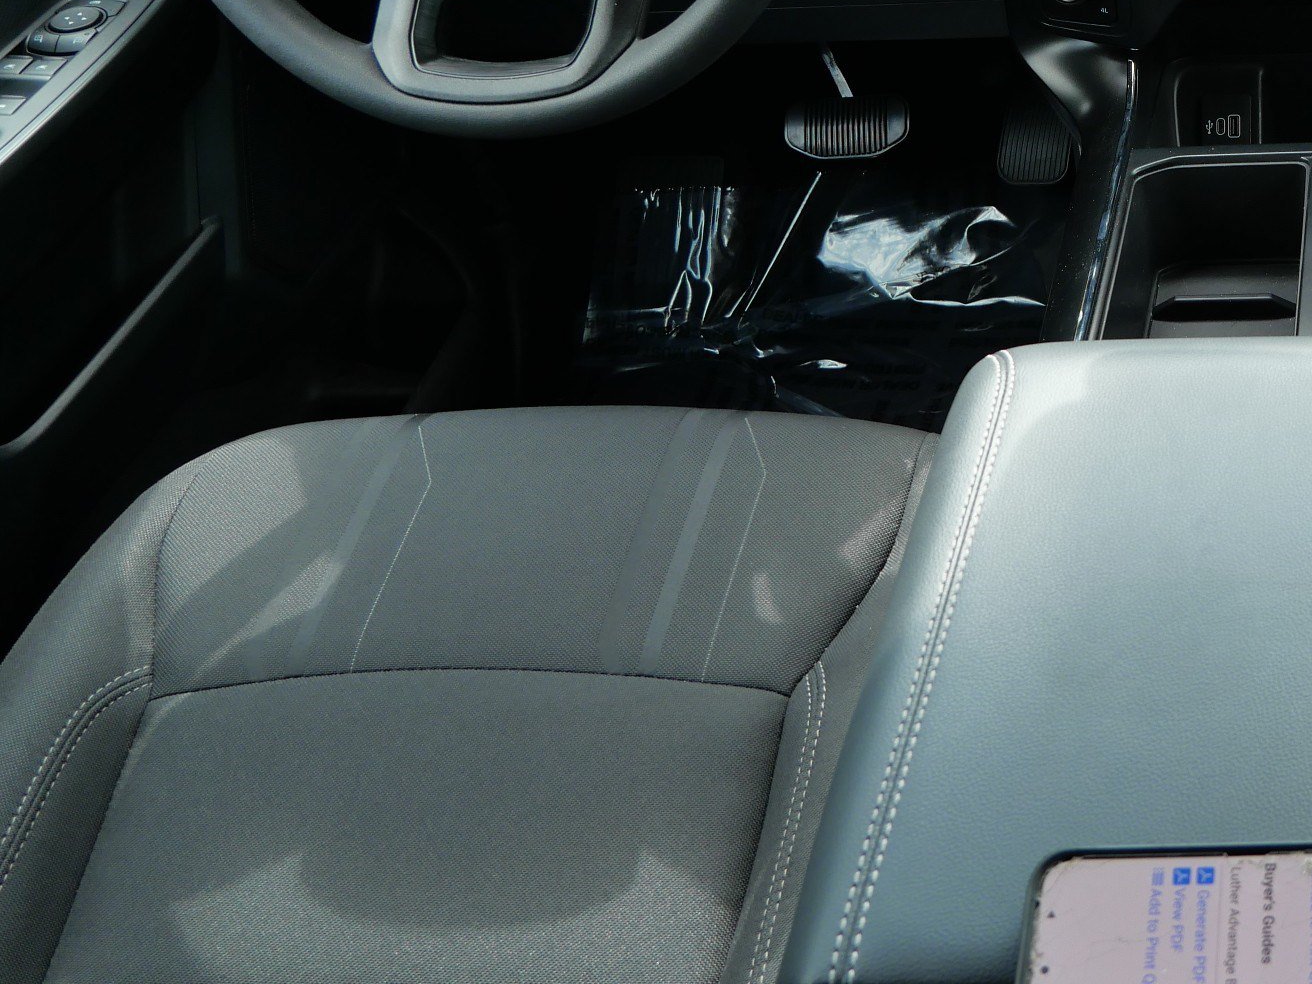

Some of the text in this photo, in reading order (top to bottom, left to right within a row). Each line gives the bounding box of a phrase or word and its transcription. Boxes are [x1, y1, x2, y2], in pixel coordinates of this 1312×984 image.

[1148, 887, 1162, 916] Add
[1229, 866, 1241, 905] Luther
[1147, 919, 1159, 933] to
[1170, 887, 1185, 952] View PDF
[1192, 889, 1210, 983] Generate PDF
[1261, 863, 1277, 965] Buyer's Guides
[1143, 937, 1159, 970] Print
[1223, 908, 1239, 975] Advantage
